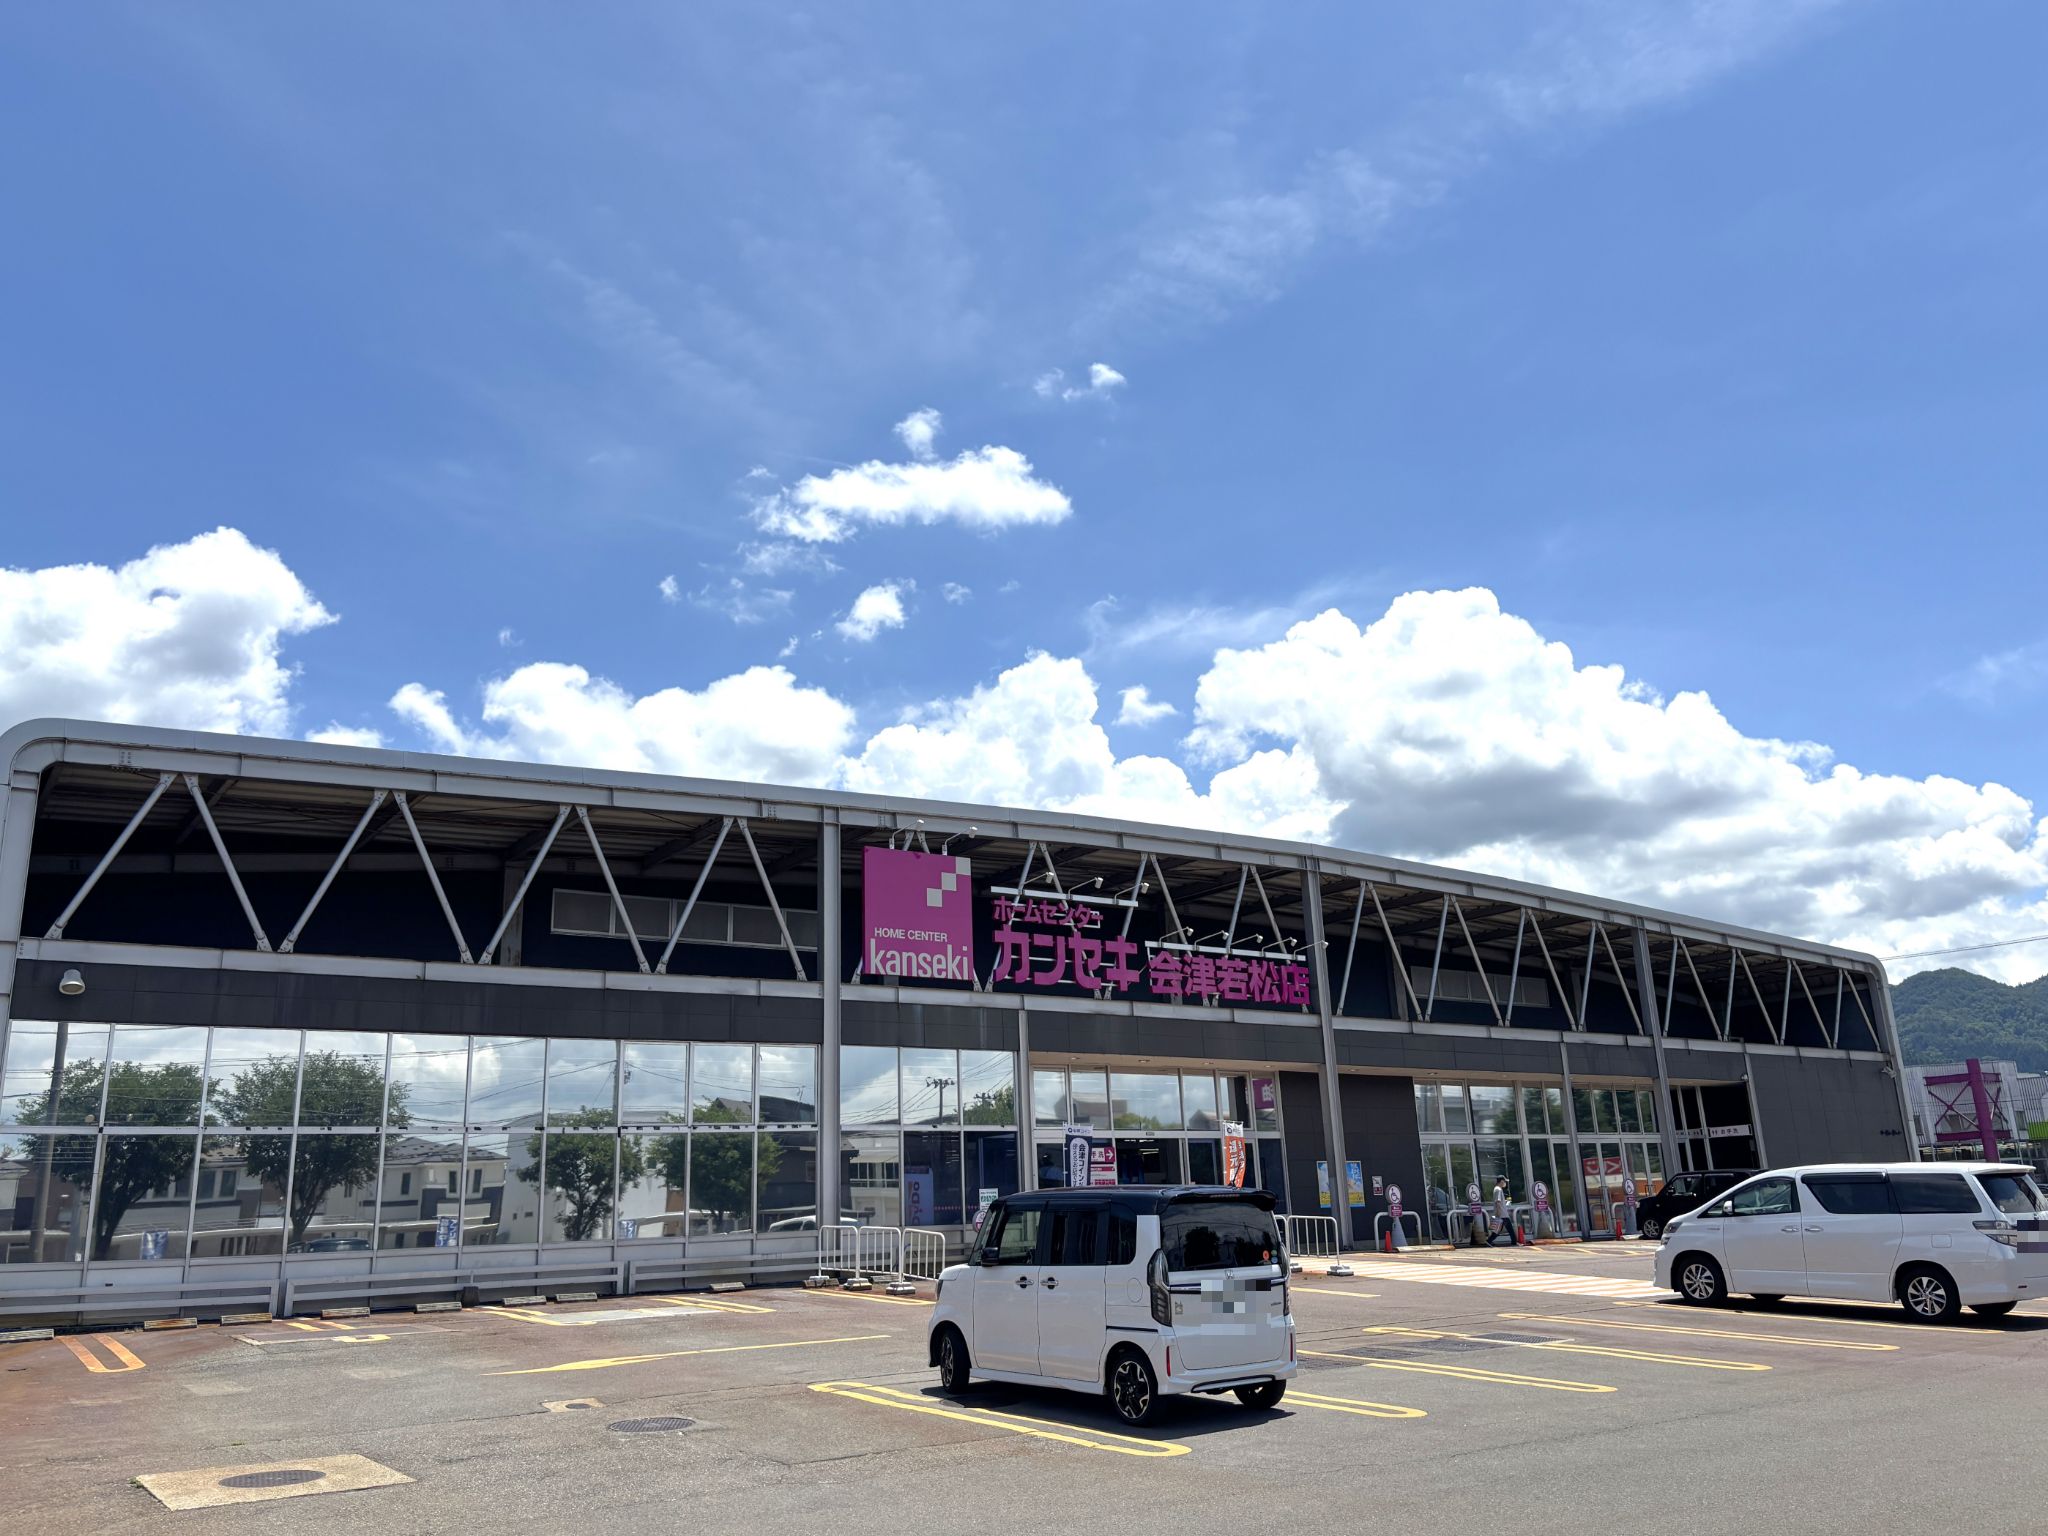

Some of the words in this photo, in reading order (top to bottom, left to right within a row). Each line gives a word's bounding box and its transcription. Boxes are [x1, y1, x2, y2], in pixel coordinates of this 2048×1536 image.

[992, 896, 1104, 926] ホームセンター
[874, 927, 905, 939] HOME
[908, 930, 948, 942] CENTER
[870, 938, 969, 980] kanseki
[993, 926, 1141, 991] カンセキ
[1149, 951, 1311, 1004] 会津若松店
